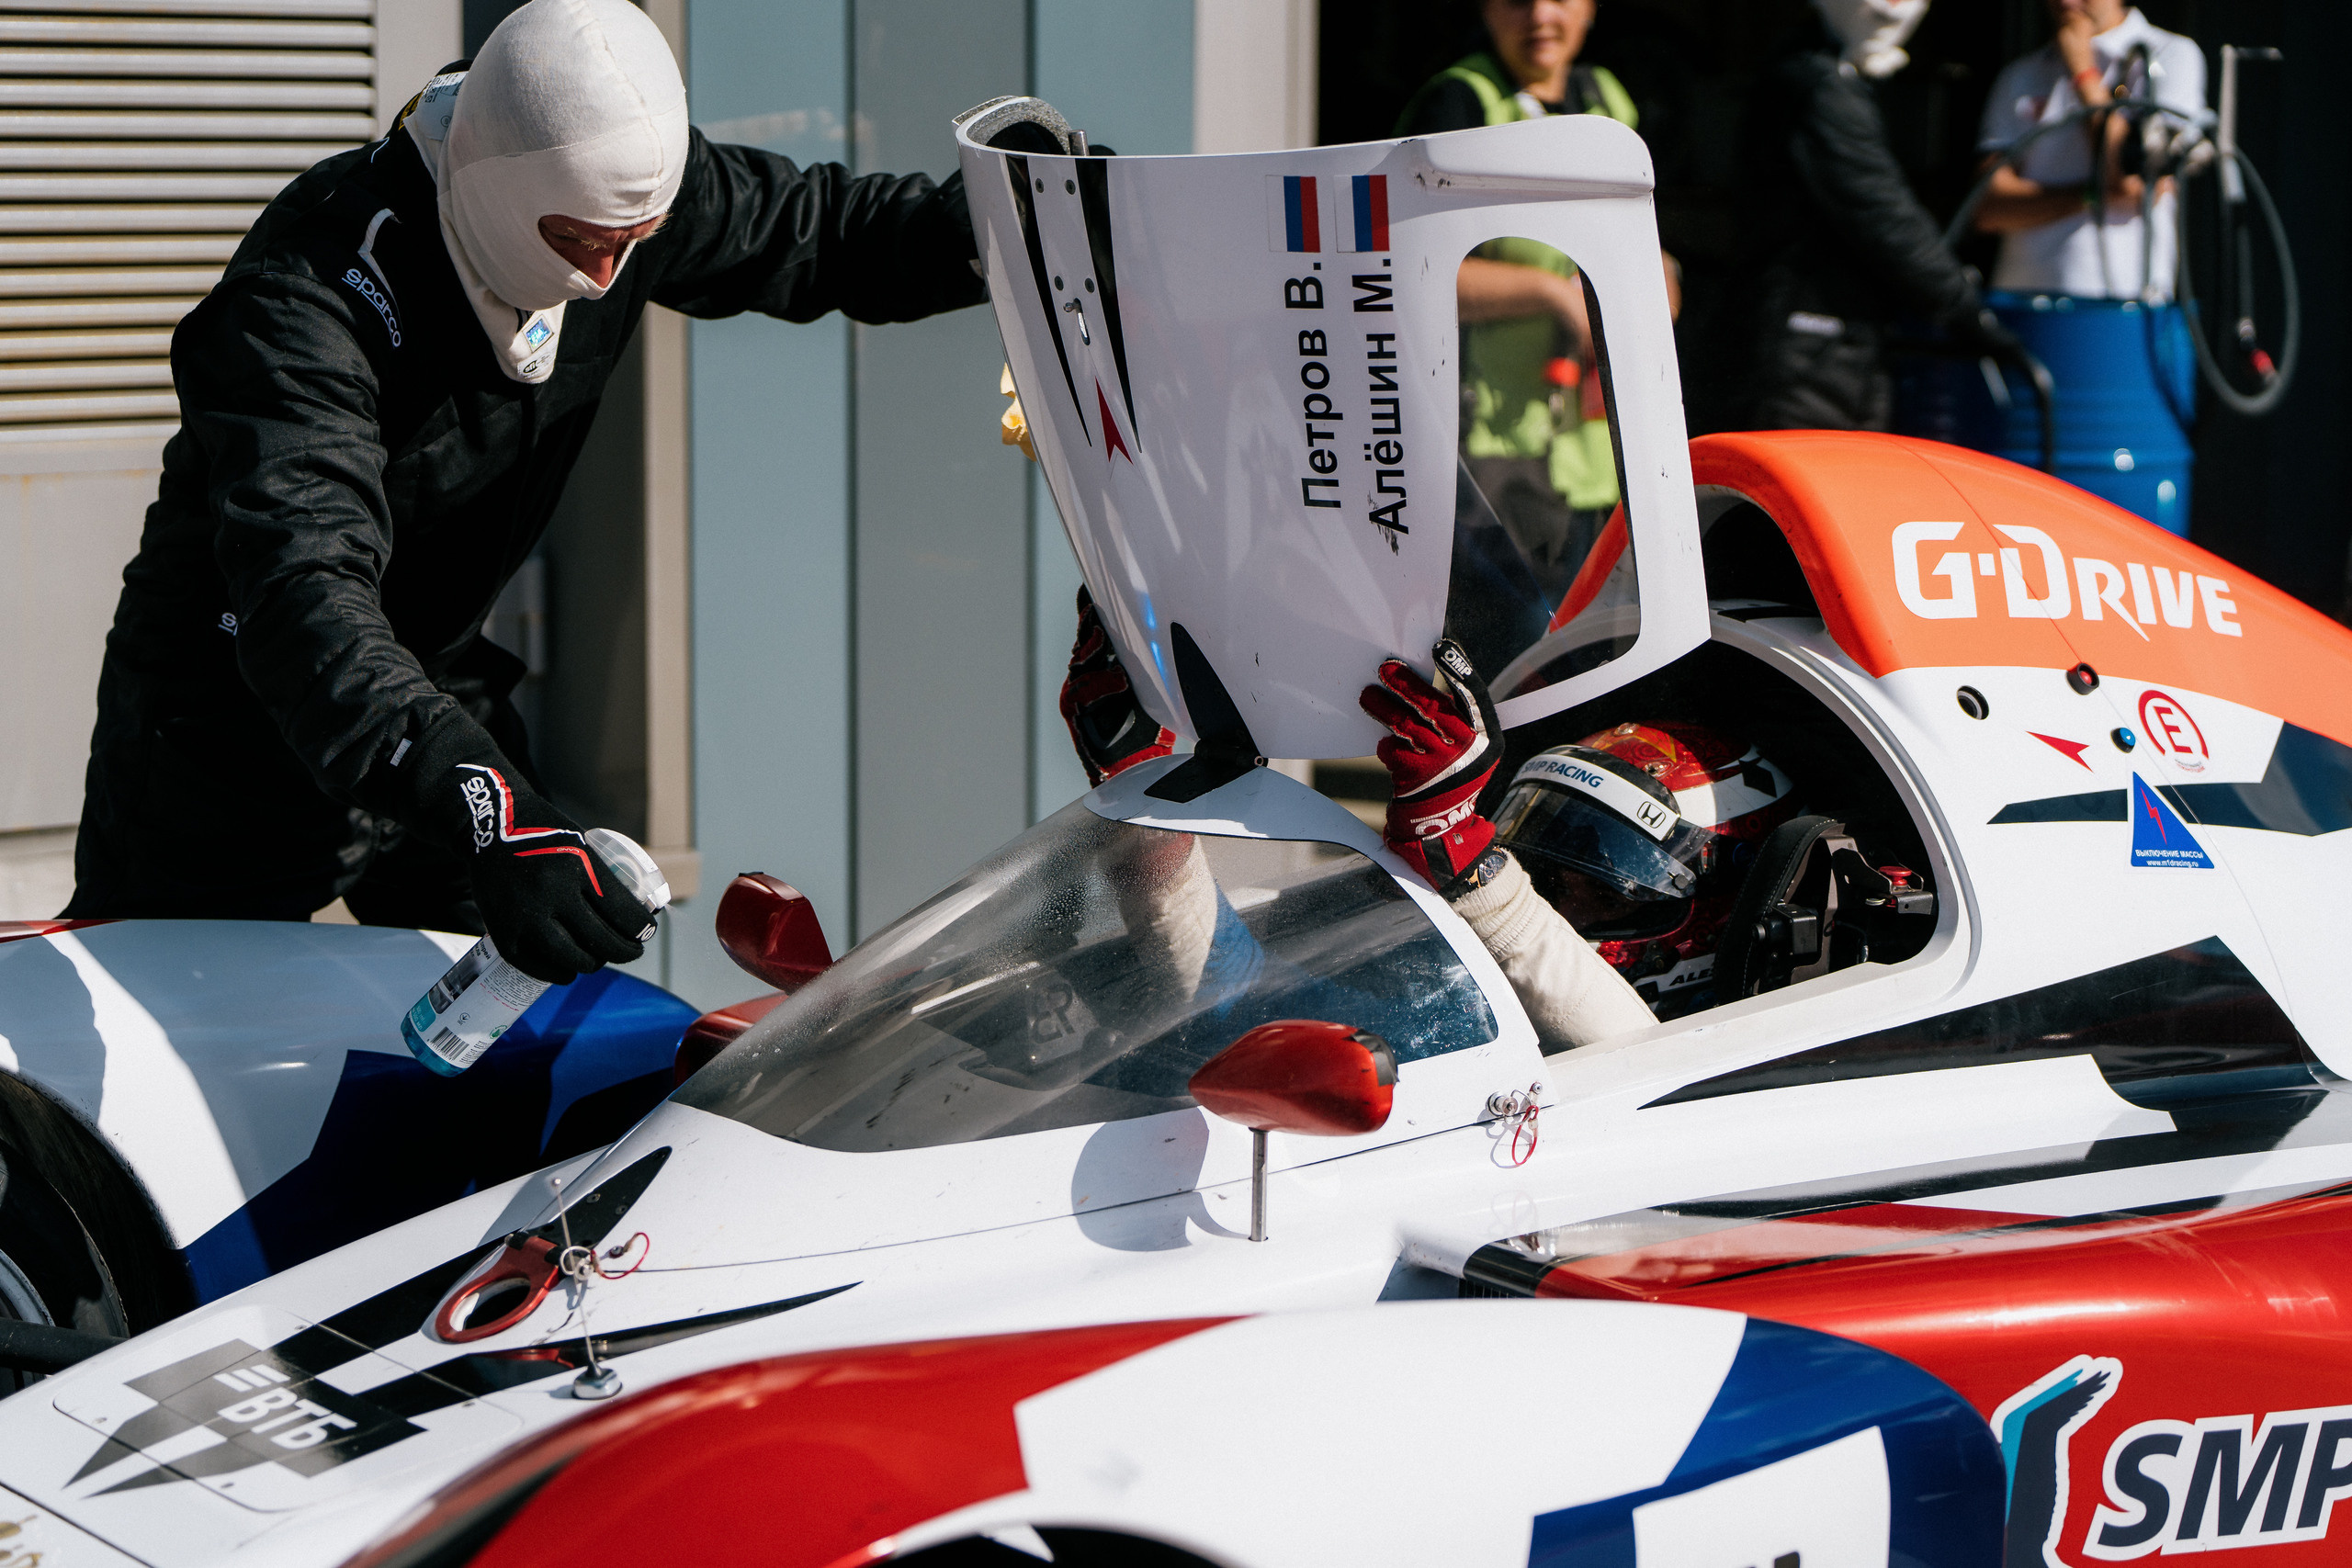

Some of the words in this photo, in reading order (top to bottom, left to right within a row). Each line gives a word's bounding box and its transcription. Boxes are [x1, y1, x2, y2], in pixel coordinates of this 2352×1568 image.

[344, 268, 401, 348] sparco
[1283, 261, 1325, 310] В.
[1351, 258, 1395, 313] М.
[1298, 328, 1344, 509] Петров
[1363, 333, 1409, 536] Алёшин
[1444, 649, 1472, 676] OMP
[2153, 705, 2194, 754] E
[1521, 760, 1548, 773] SMP
[1546, 761, 1604, 788] RACING
[462, 776, 496, 849] sparco
[2134, 849, 2180, 858] ВЫКЛЮЧЕНИЕ
[2179, 850, 2204, 859] МАССЫ
[217, 1387, 358, 1450] ВТБ
[2097, 1417, 2352, 1547] SMP
